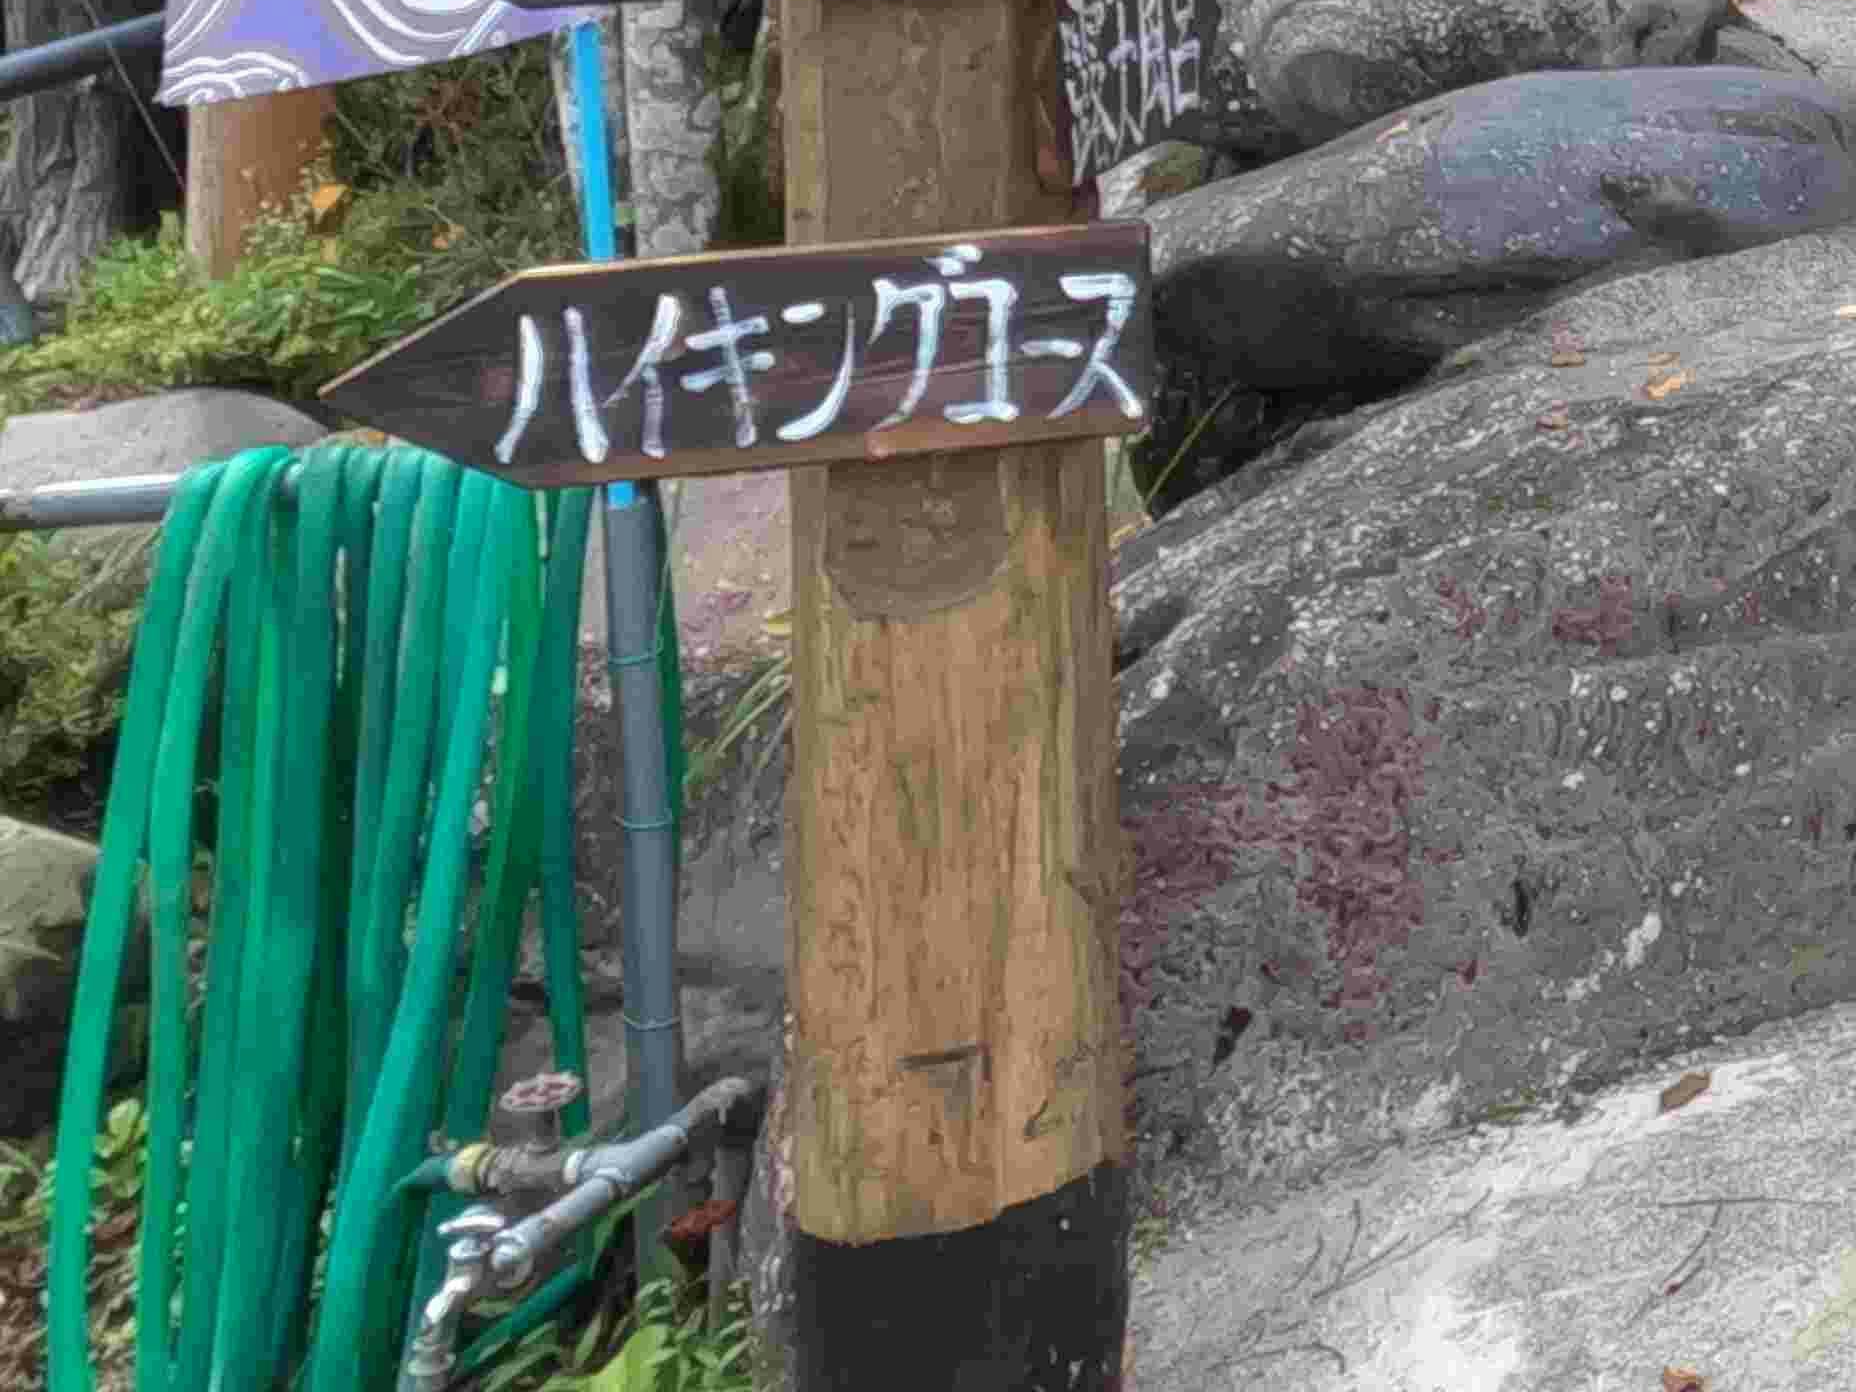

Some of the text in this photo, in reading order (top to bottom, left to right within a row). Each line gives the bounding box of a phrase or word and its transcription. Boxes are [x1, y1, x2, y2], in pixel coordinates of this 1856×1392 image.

[493, 243, 1145, 464] ハイキングコース
